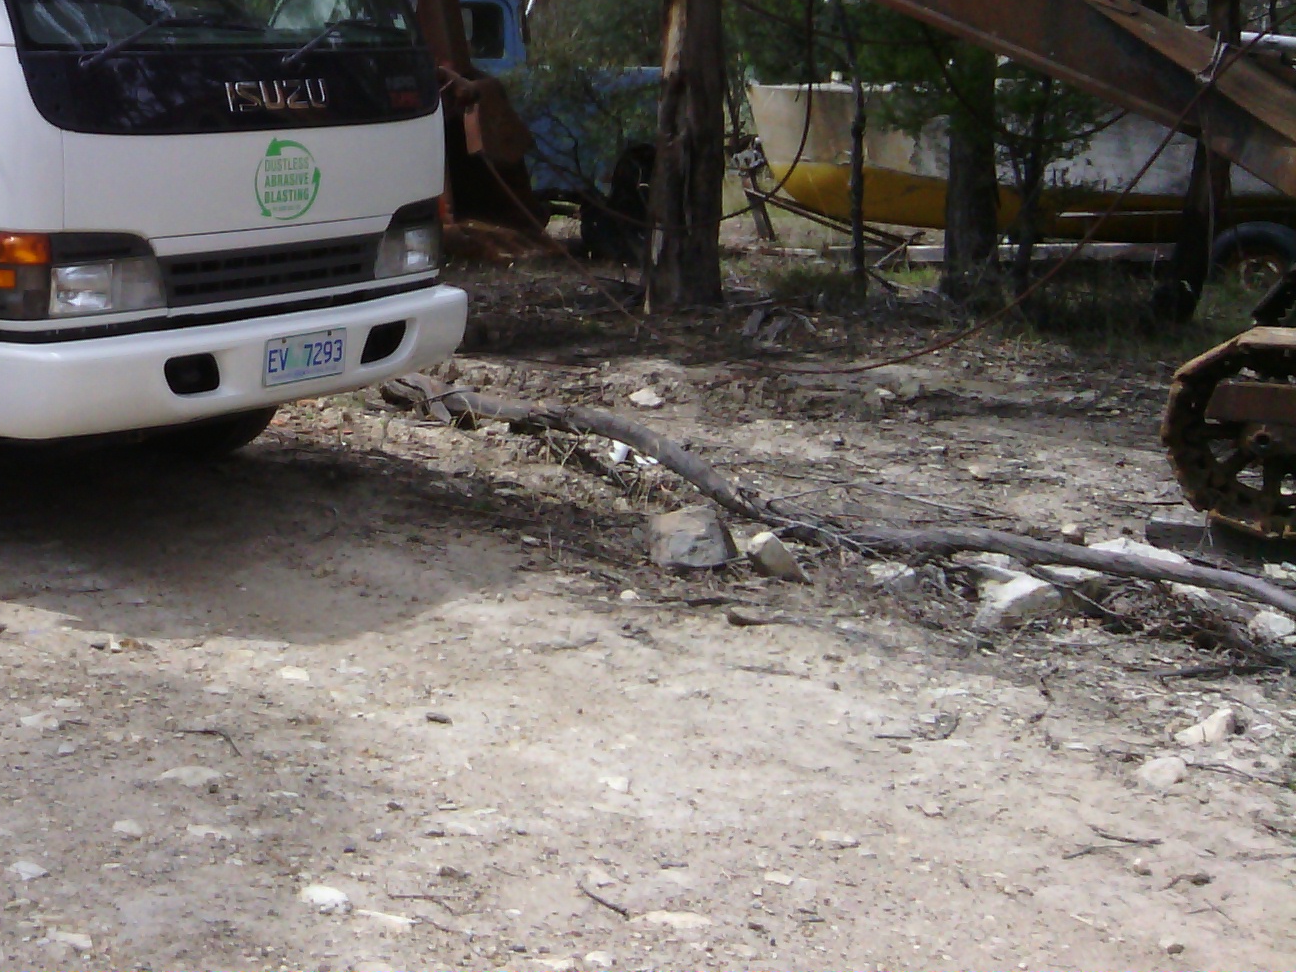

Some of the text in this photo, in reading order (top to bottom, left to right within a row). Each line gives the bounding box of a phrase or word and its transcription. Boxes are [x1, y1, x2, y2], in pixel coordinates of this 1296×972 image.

[225, 78, 327, 112] ISUZU
[265, 157, 309, 172] DUSTLESS
[264, 172, 309, 188] ABRASIVE
[264, 188, 309, 204] BLASTING
[268, 348, 289, 373] EV
[304, 339, 343, 367] 7293
